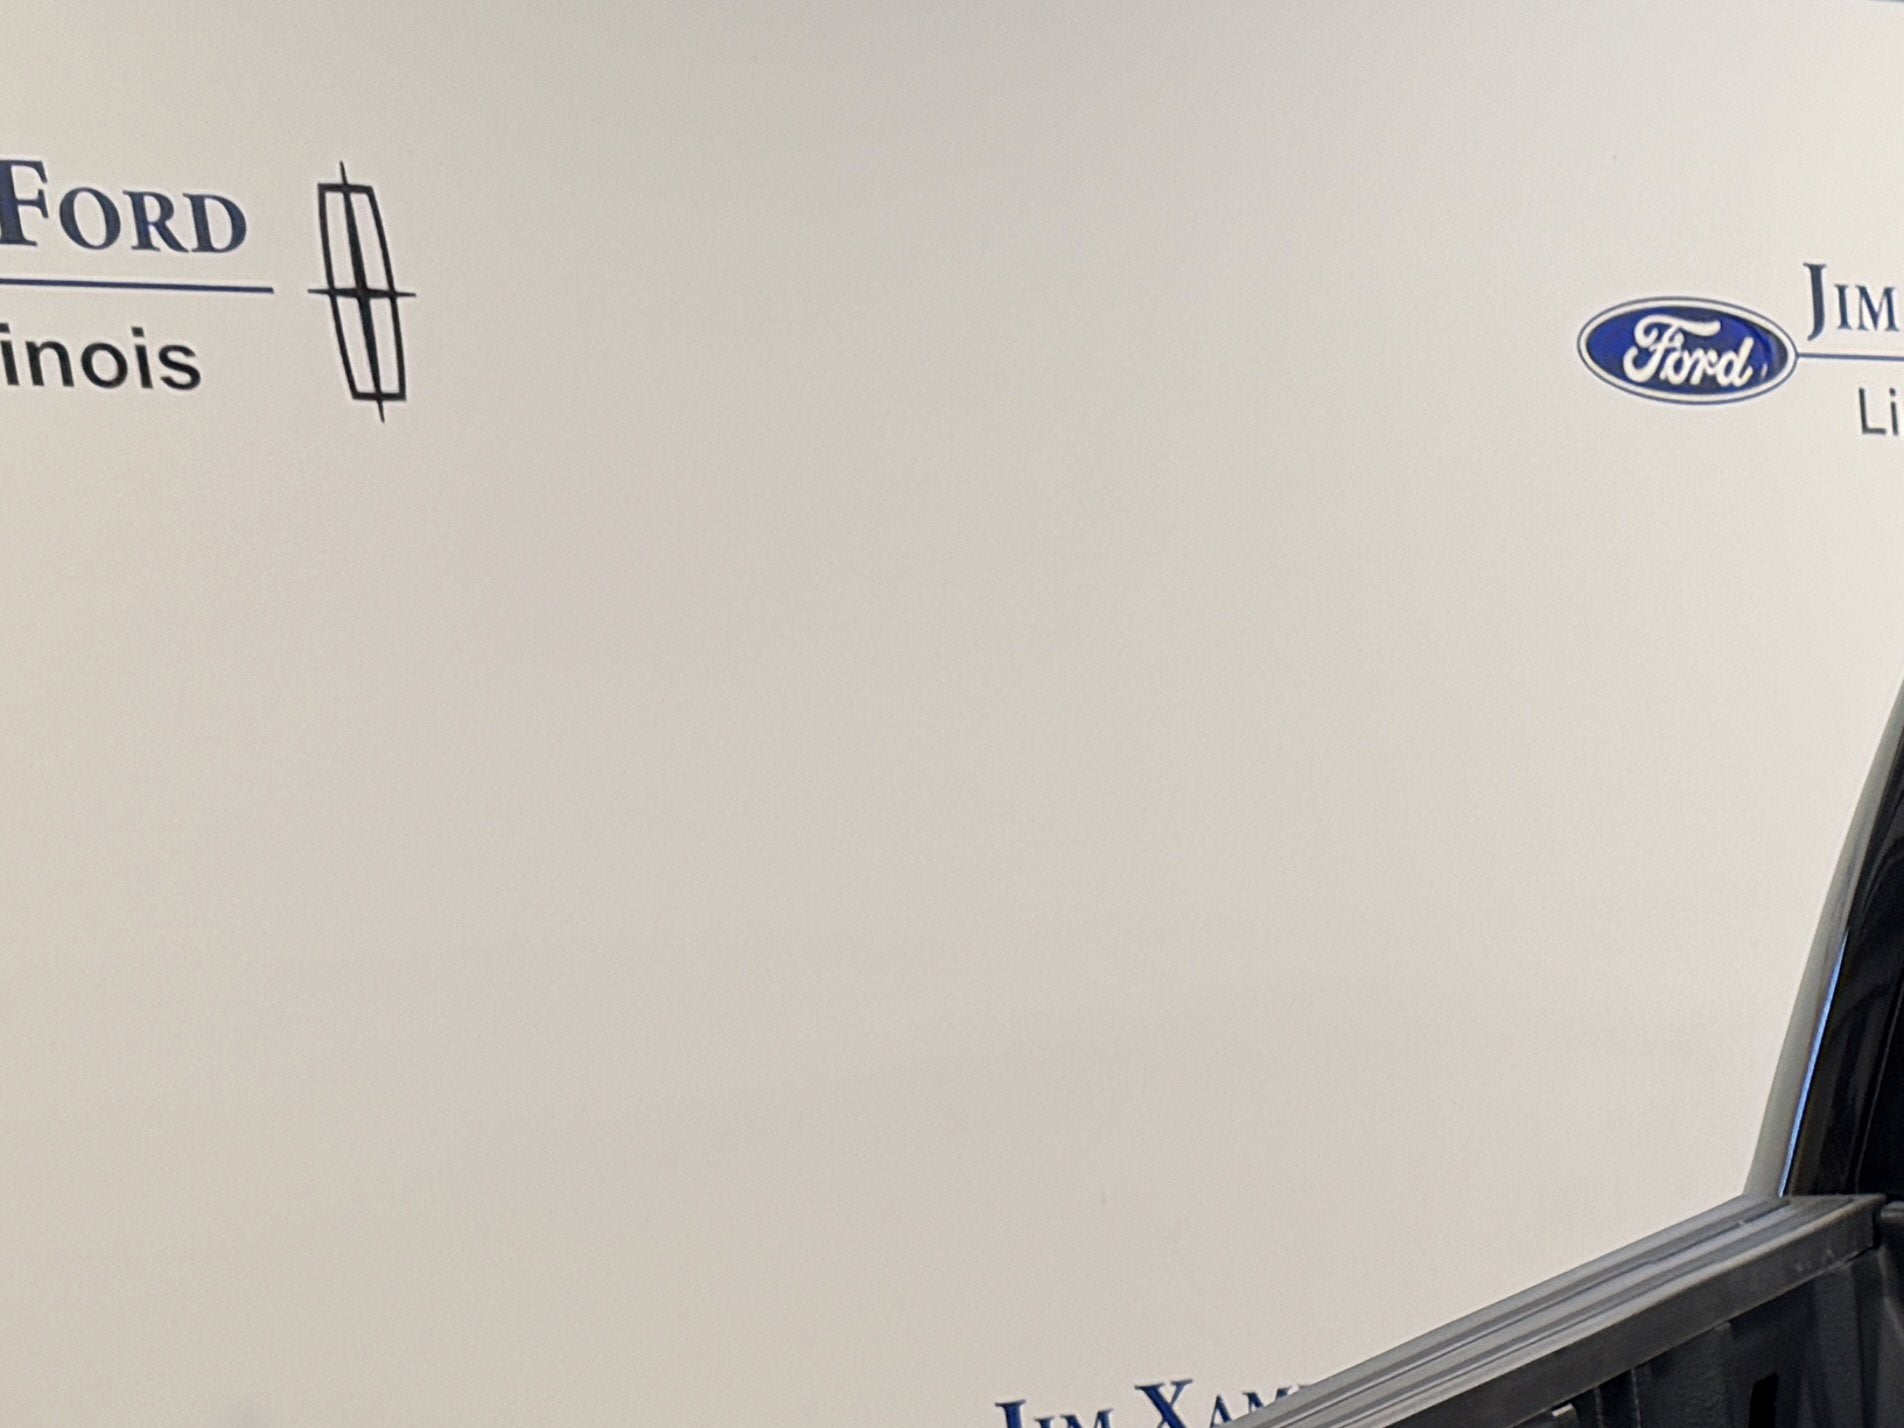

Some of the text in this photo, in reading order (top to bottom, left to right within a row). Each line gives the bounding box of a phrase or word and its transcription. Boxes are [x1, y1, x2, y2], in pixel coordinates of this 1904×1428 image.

[0, 160, 247, 253] FORD
[1803, 262, 1898, 341] JIM
[1622, 313, 1755, 388] Ford
